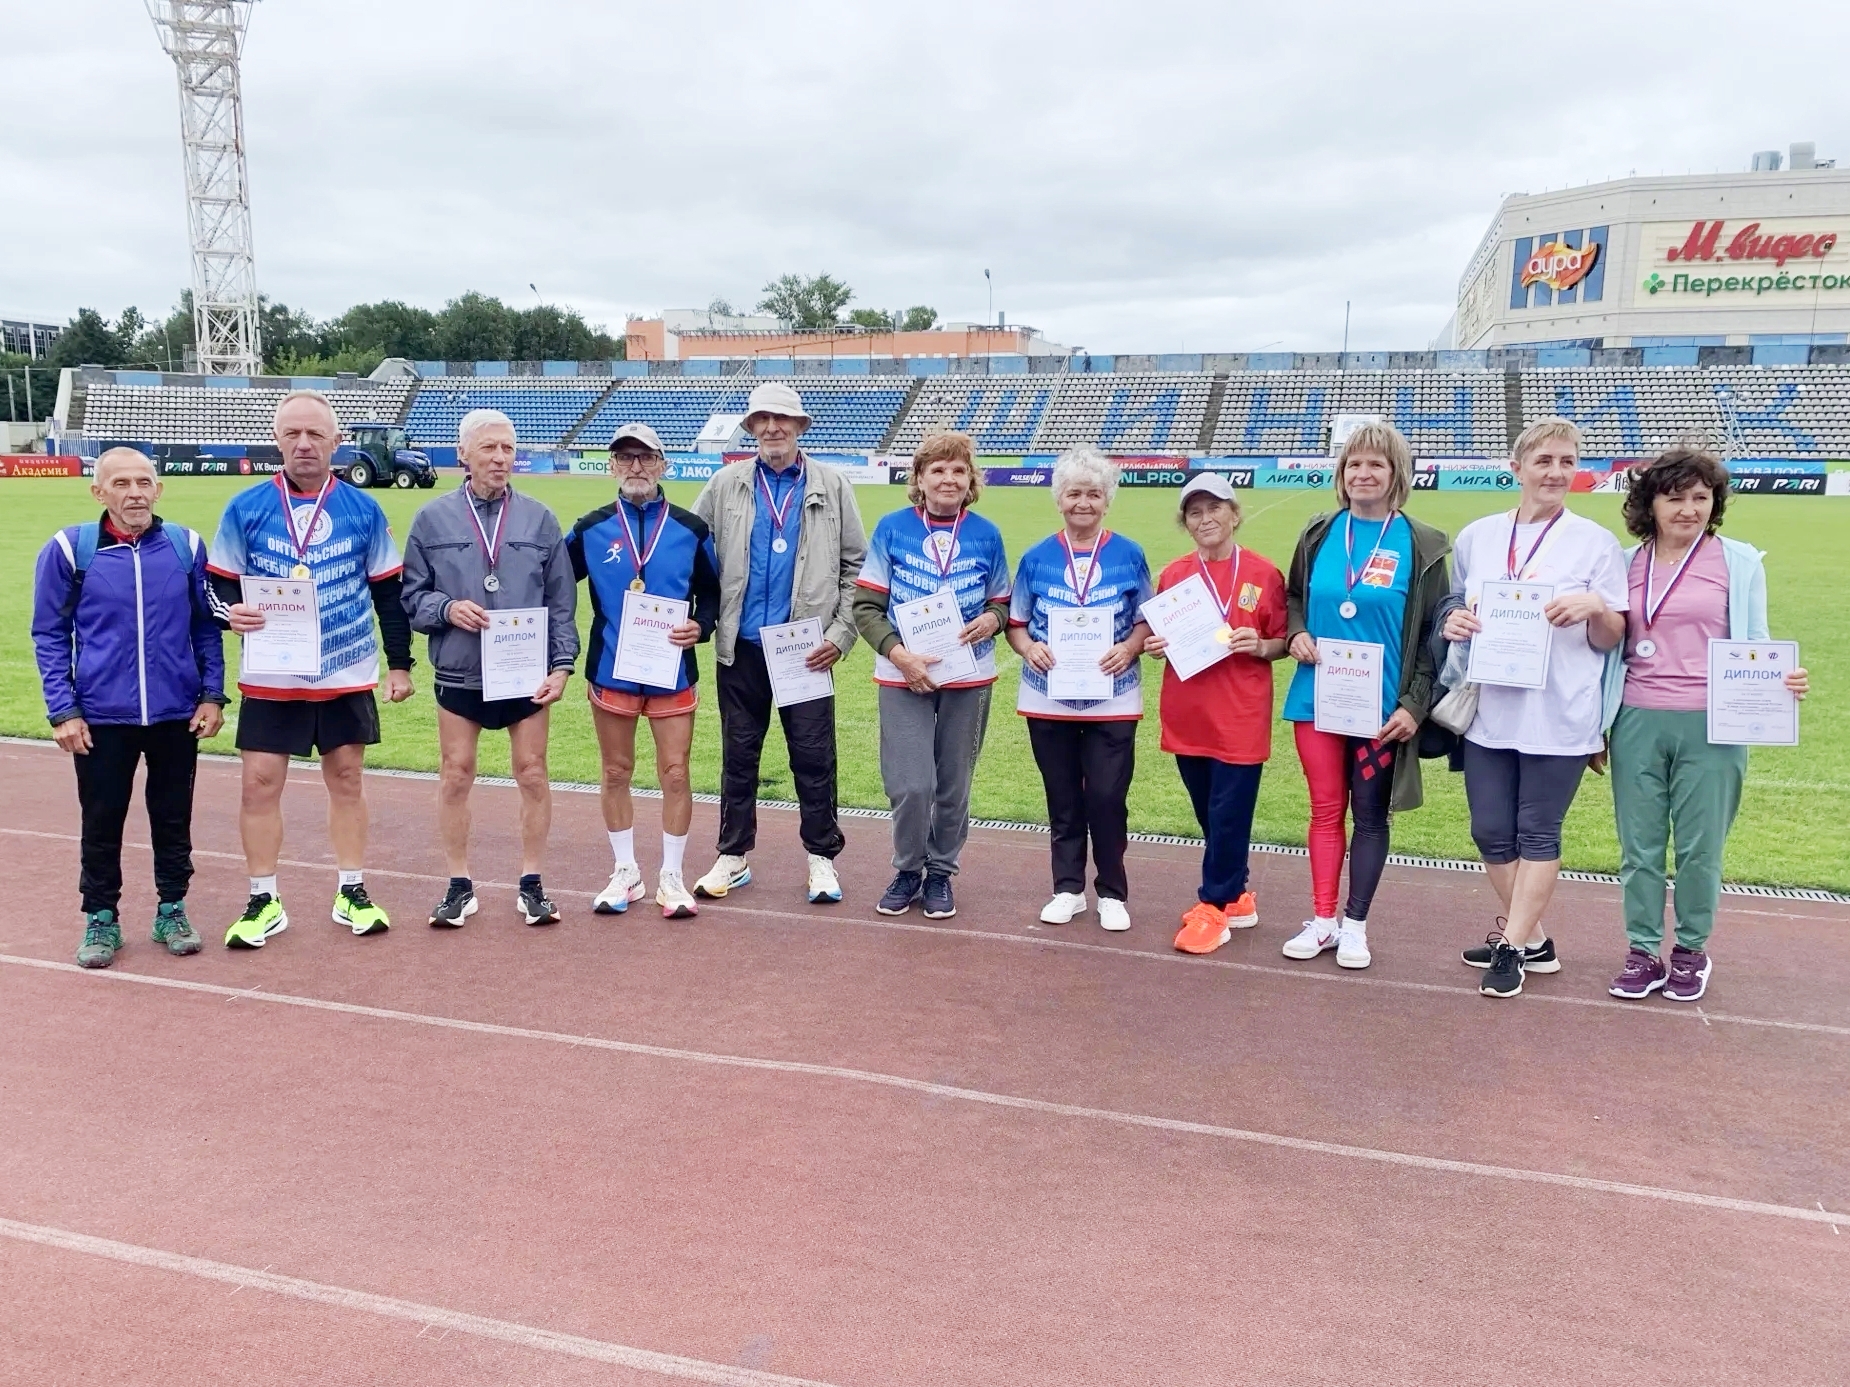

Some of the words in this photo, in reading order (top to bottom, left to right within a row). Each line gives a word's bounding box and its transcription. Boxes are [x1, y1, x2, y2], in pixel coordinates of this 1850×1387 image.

[1529, 253, 1582, 279] аура
[1673, 271, 1850, 297] Перекрёсток
[12, 464, 69, 477] Академия
[165, 462, 193, 472] PARI
[200, 462, 228, 472] PARI
[681, 467, 713, 478] JAKO
[1266, 475, 1304, 483] ЛИГА
[1452, 476, 1491, 485] ЛИГА
[1729, 478, 1760, 490] ARI
[1772, 478, 1821, 490] PARI
[1048, 585, 1118, 605] ОКТЯБЬСКИЙ
[258, 603, 306, 612] ДИПЛОМ
[1162, 599, 1202, 627] ДИПЛОМ
[1490, 608, 1541, 621] ДИПЛОМ
[632, 617, 675, 630] ДИПЛОМ
[912, 616, 952, 636] ДИПЛОМ
[493, 632, 536, 644] ДИПЛОМ
[1060, 632, 1102, 643] ДИПЛОМ
[775, 641, 815, 655] ДИПЛОМ
[1327, 665, 1370, 678] ДИПЛОМ
[1723, 669, 1782, 680] ДИПЛОМ
